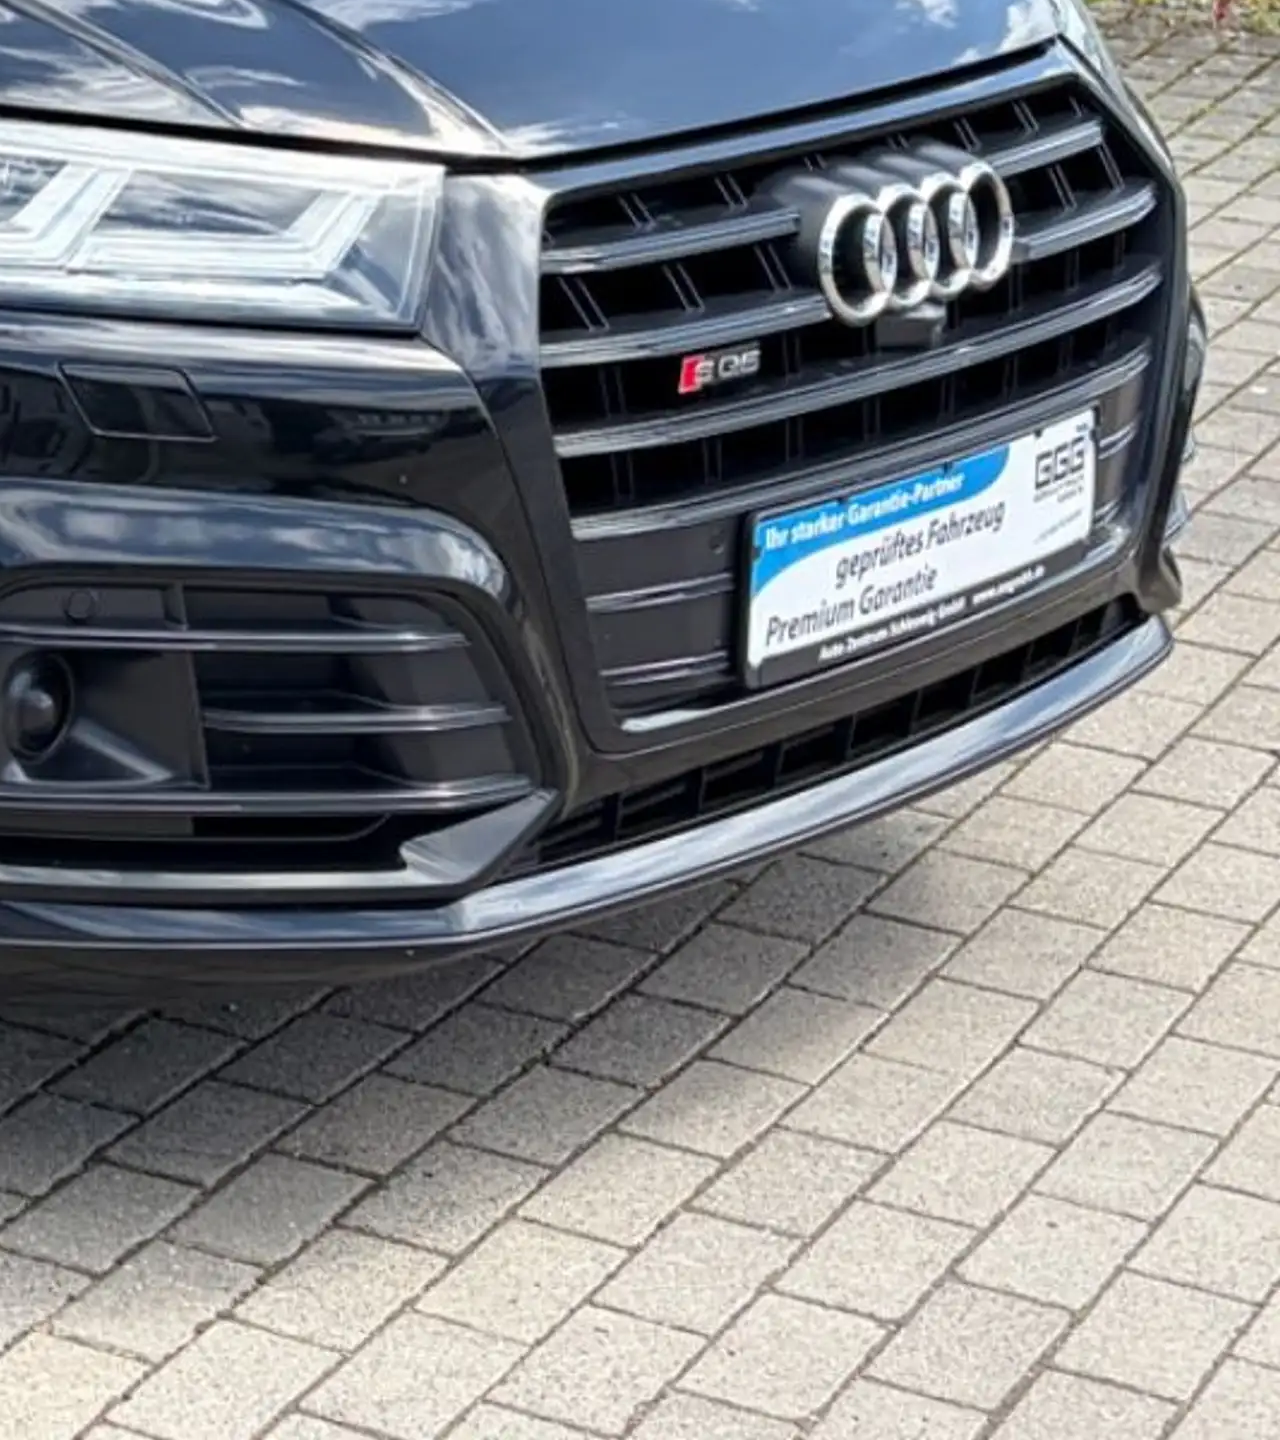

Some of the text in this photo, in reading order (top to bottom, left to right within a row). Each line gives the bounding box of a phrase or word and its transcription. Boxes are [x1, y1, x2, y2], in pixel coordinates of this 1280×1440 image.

[696, 350, 761, 384] SQ5
[765, 472, 965, 550] Ihr starker Garantie-Partner
[835, 527, 924, 589] geprüftes
[926, 501, 1006, 554] Fahrzeug
[766, 596, 856, 647] Premium
[859, 563, 937, 615] Garantie
